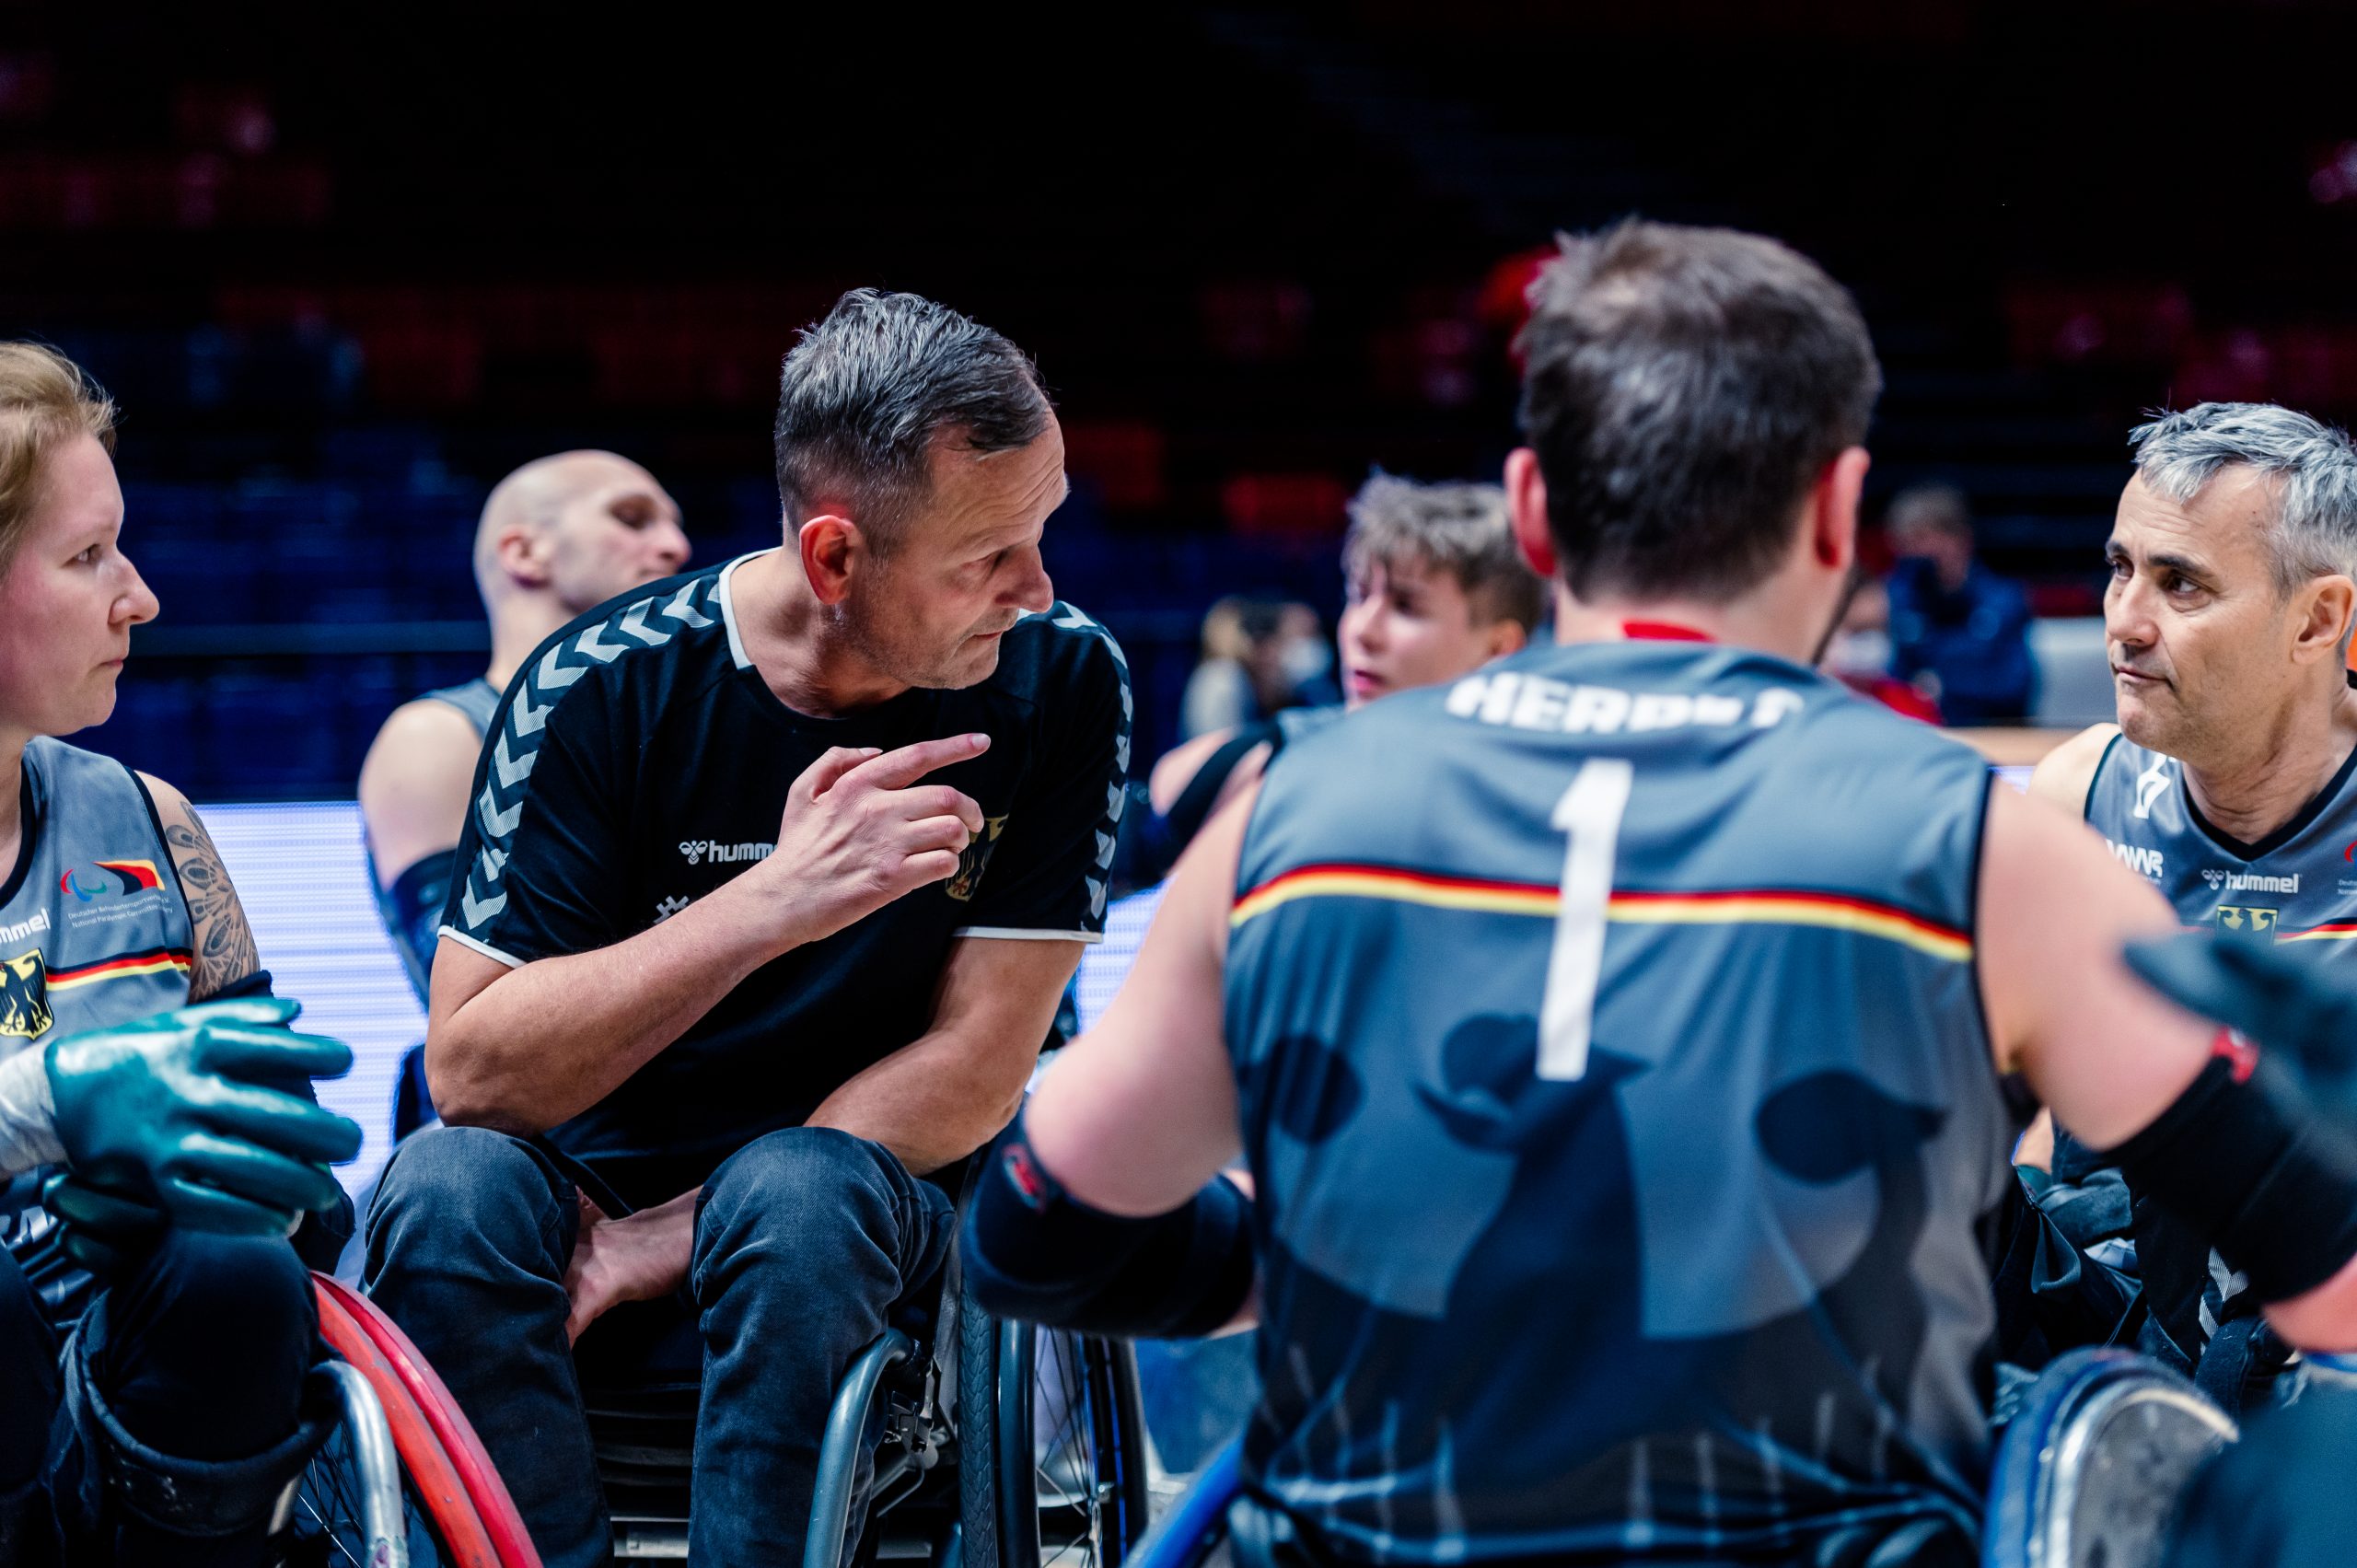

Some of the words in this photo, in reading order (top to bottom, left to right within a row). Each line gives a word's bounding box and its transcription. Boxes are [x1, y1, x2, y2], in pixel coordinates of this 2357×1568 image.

[708, 840, 778, 863] humm
[2224, 871, 2299, 893] hummel
[1535, 756, 1634, 1083] 1
